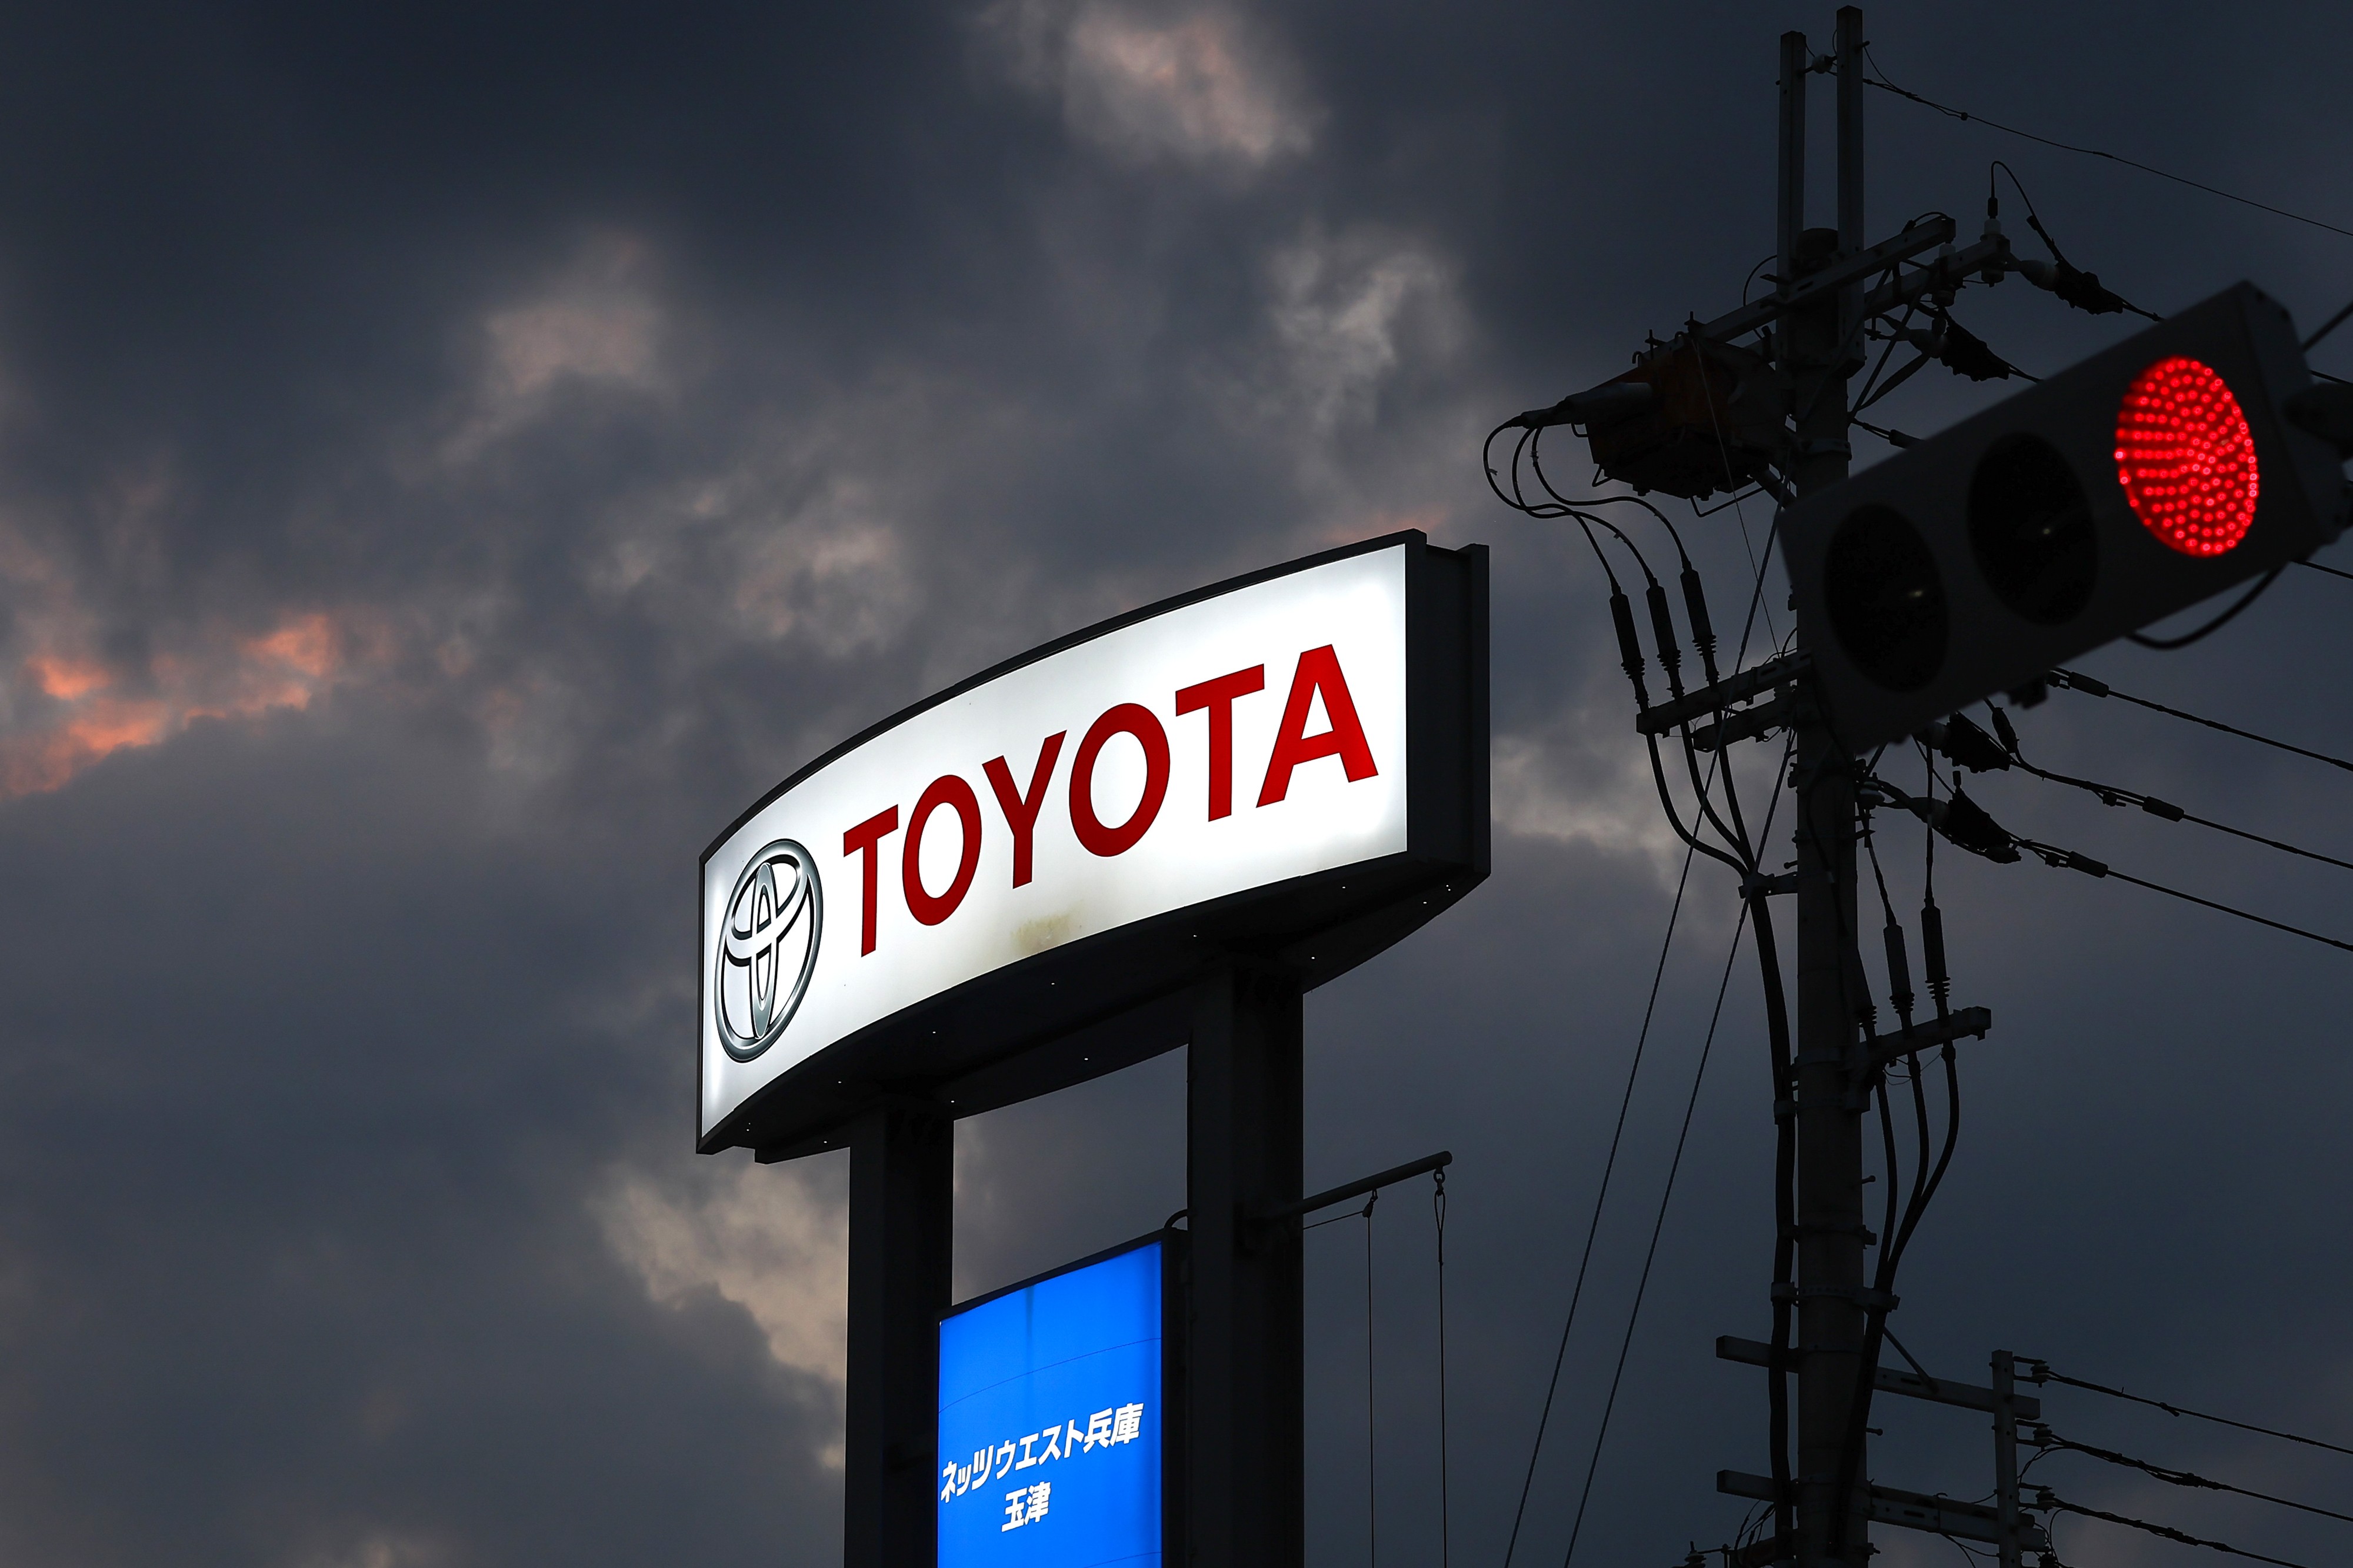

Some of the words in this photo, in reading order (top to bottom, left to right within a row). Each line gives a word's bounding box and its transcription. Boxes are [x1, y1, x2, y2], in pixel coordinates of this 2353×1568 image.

[843, 643, 1379, 958] TOYOTA
[940, 1402, 1144, 1504] ネッツウエスト兵庫
[1001, 1481, 1051, 1533] 玉津
